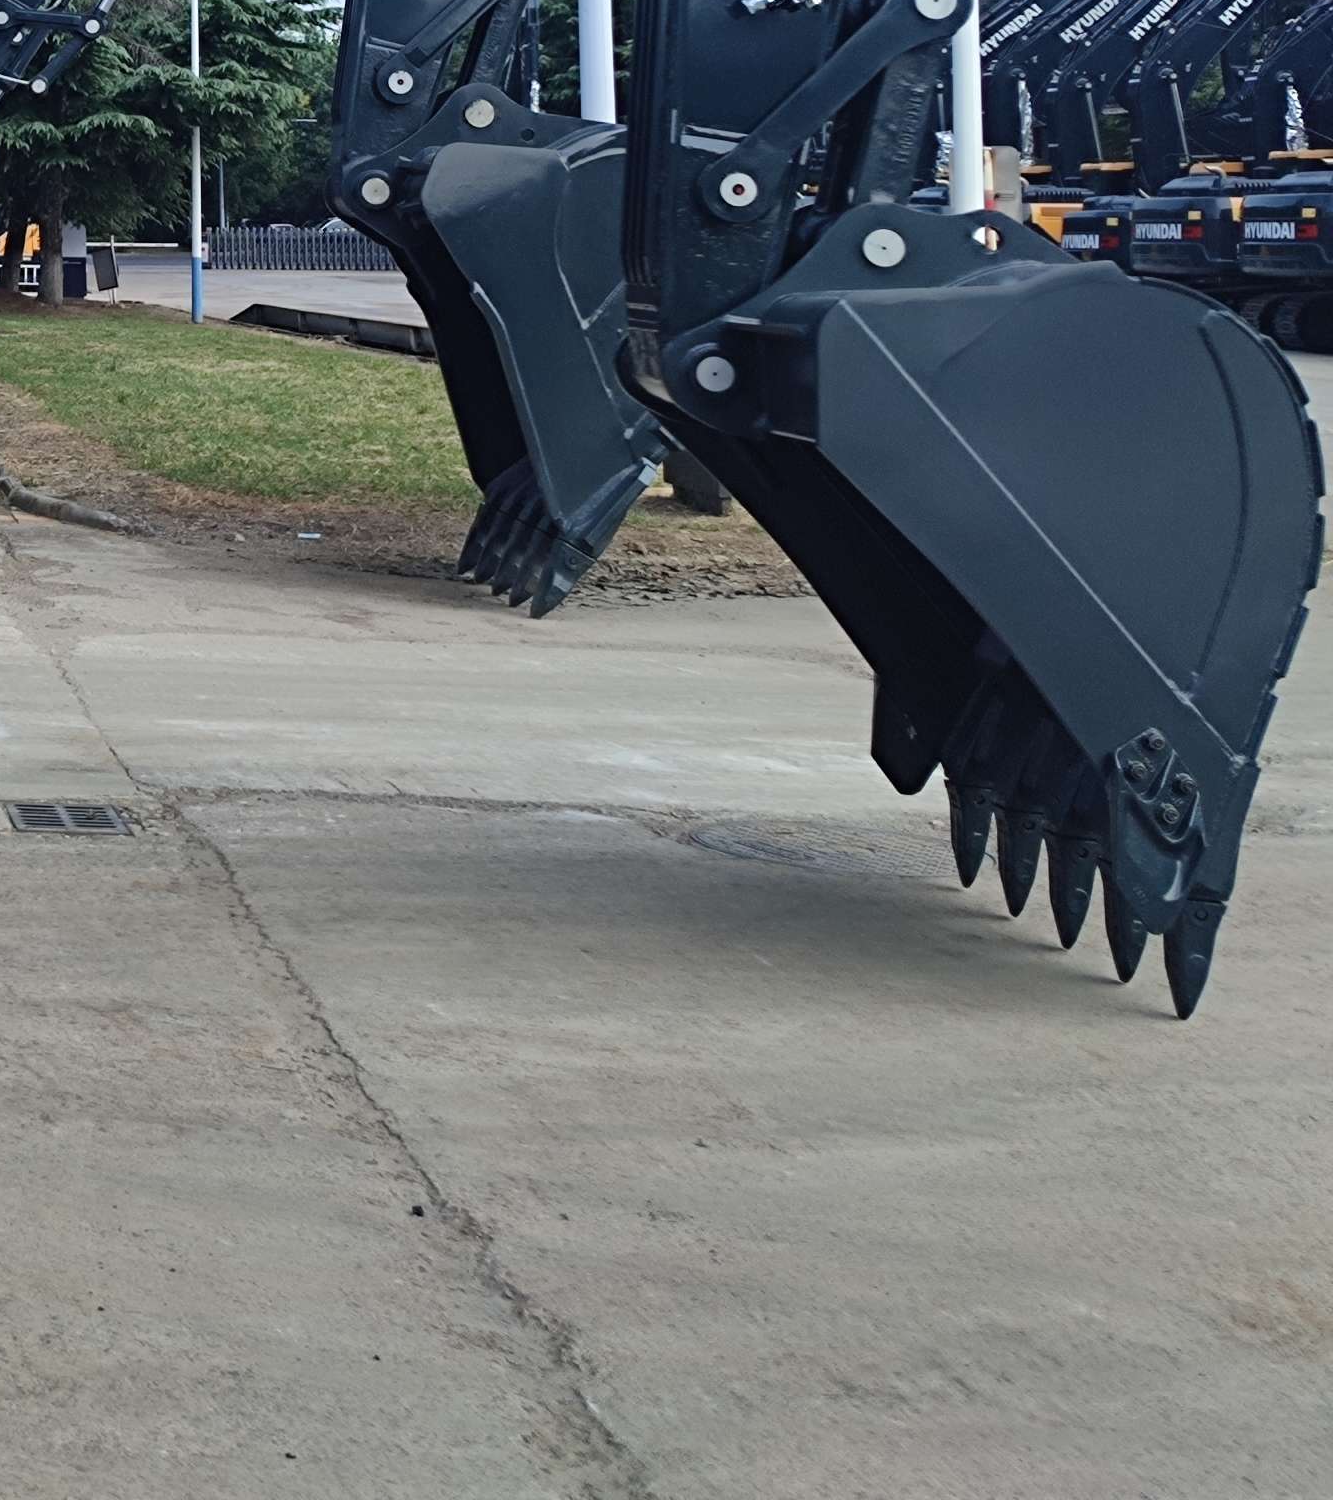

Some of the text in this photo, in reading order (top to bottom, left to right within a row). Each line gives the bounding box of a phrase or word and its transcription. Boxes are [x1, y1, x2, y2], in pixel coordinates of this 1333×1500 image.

[980, 3, 1044, 57] HYUNDAI
[1134, 222, 1182, 240] HYUNDAI
[1244, 221, 1296, 240] HYUNDAI
